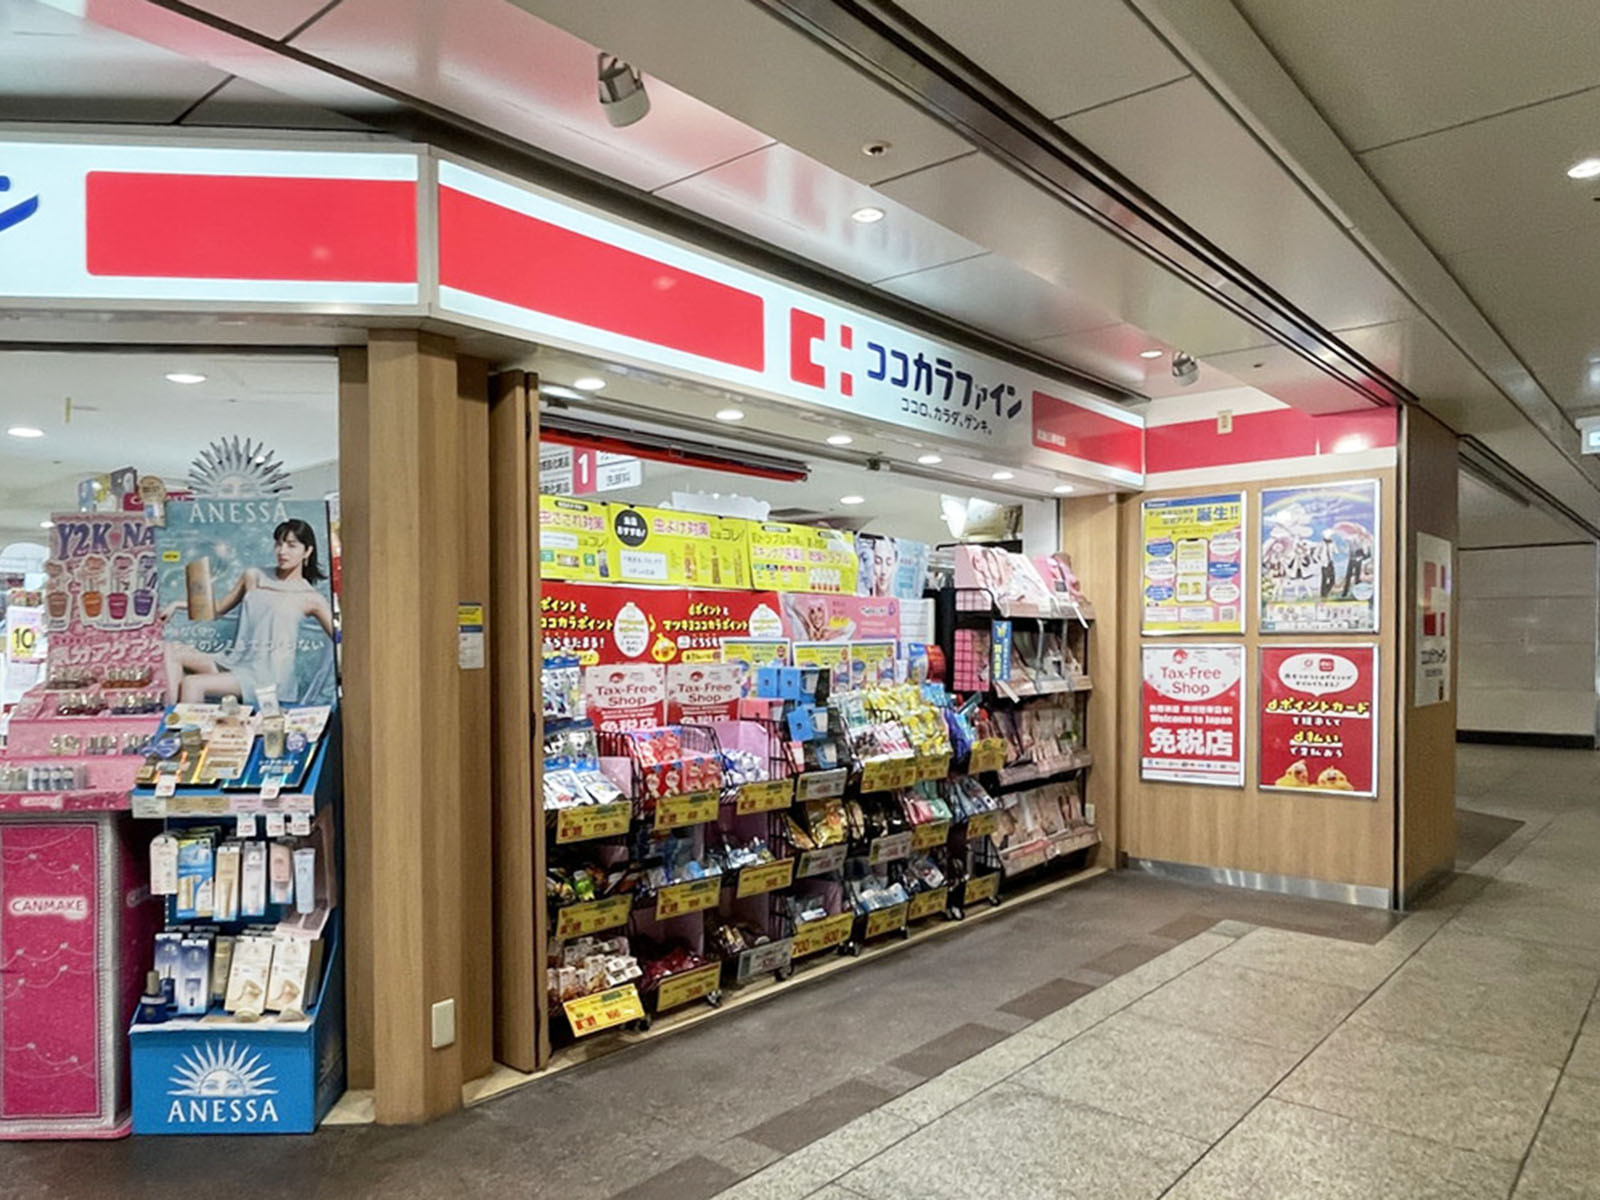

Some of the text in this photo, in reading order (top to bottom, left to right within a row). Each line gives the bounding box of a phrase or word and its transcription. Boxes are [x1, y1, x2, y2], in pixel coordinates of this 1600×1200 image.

[867, 341, 1022, 419] ココカラファイン
[578, 453, 588, 485] 1
[189, 502, 289, 524] ANESSA
[58, 523, 111, 560] Y2K
[1160, 665, 1222, 680] Tax-Free
[595, 684, 657, 696] Tax-Free
[677, 682, 732, 694] Tax-Free
[1172, 681, 1210, 697] Shop
[608, 696, 647, 707] Shop
[688, 693, 722, 704] Shop
[1267, 697, 1370, 714] dポイントカード
[1149, 727, 1233, 756] 免税店
[12, 900, 84, 912] CANMAKE
[167, 1099, 279, 1123] ANESSA
